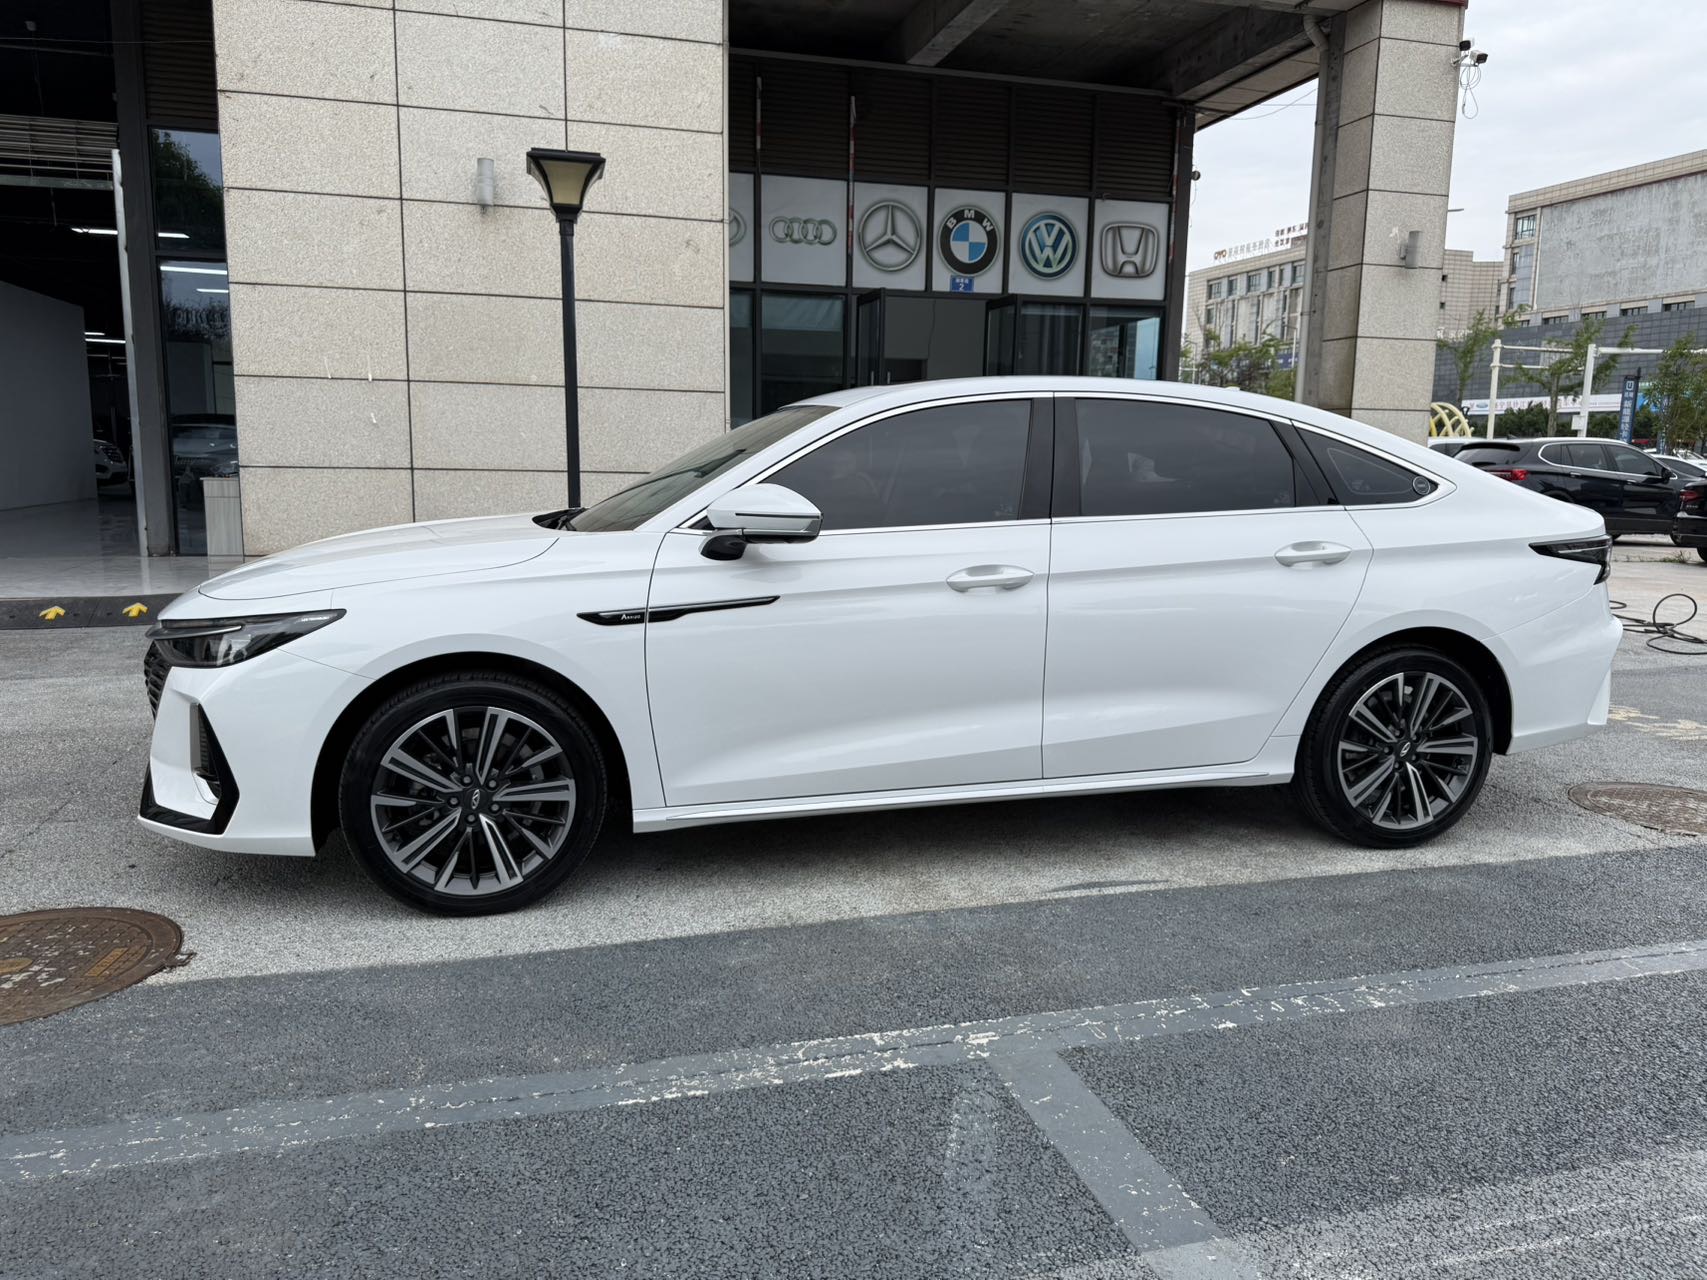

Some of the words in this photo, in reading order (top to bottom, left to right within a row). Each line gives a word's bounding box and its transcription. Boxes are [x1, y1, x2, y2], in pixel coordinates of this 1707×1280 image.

[946, 209, 993, 231] BMW
[1214, 249, 1226, 260] OYO
[959, 283, 966, 291] 2
